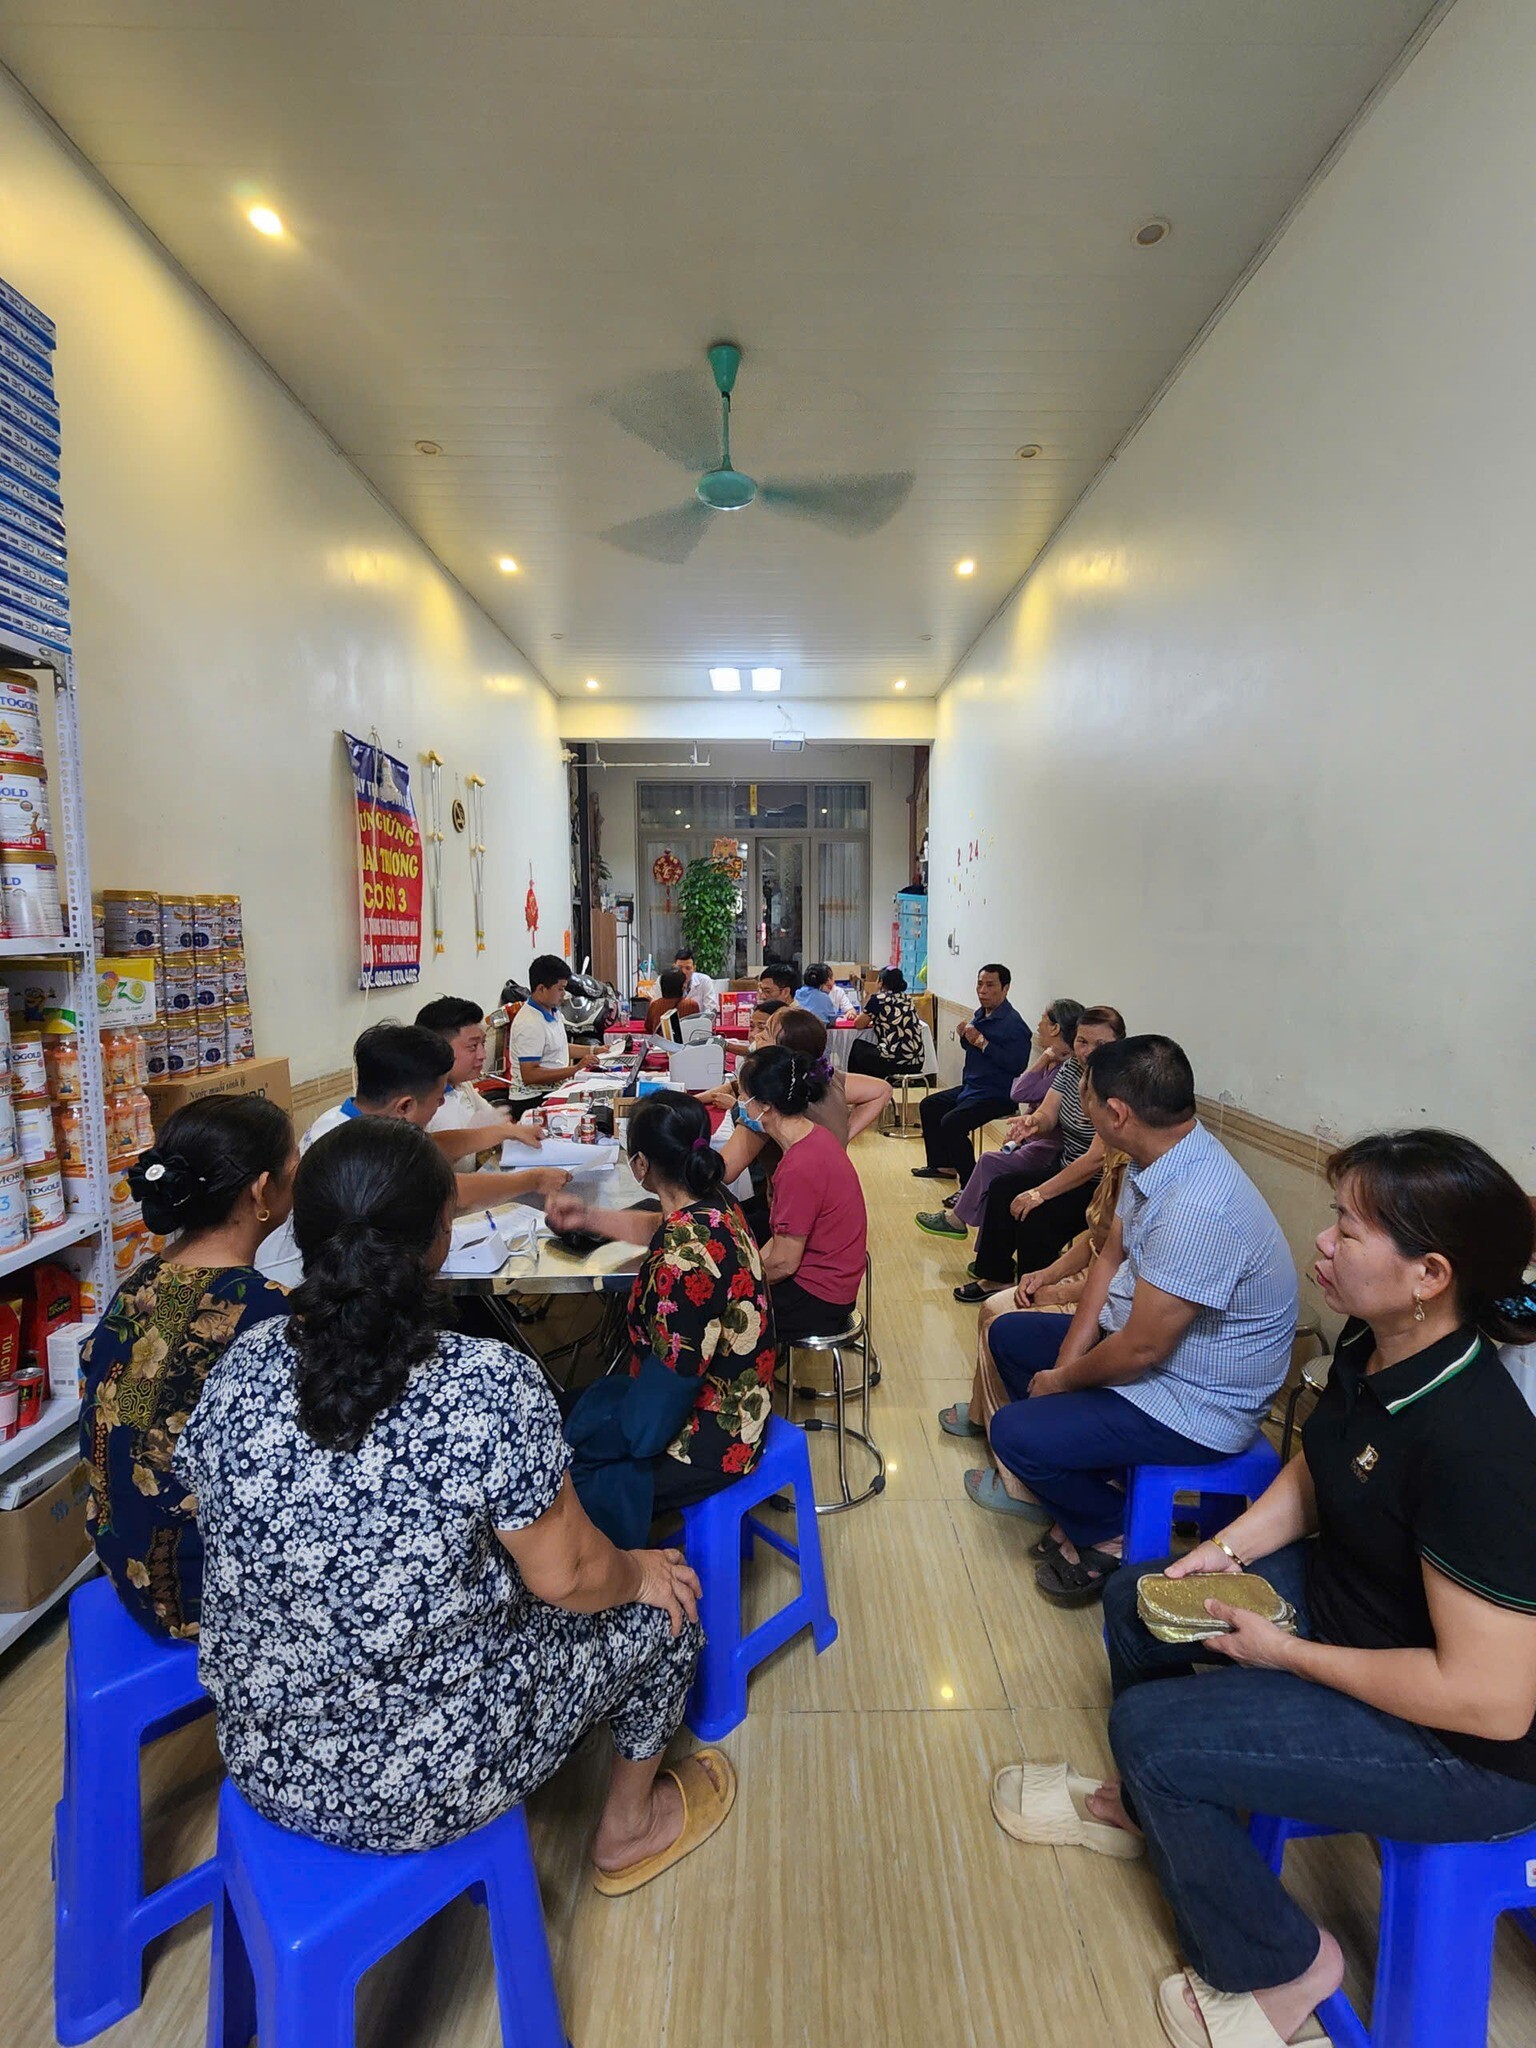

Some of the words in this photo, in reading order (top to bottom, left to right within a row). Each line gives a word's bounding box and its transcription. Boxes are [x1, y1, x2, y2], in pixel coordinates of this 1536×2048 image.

[7, 292, 21, 310] 3D
[25, 307, 54, 337] MASK
[3, 316, 17, 334] 3D
[20, 330, 52, 359] MASK
[4, 345, 19, 362] 3D
[22, 359, 52, 386] MASK
[11, 377, 26, 394] 3D
[28, 389, 57, 416] MASK
[13, 404, 27, 420] 3D
[30, 416, 59, 441] MASK
[13, 431, 27, 446] 3D
[30, 441, 58, 467] MASK
[13, 457, 26, 472] 3D
[29, 467, 58, 492] MASK
[20, 539, 34, 552] 3D
[22, 567, 36, 580] 3D
[23, 593, 37, 606] 3D
[40, 601, 68, 620] MASK
[25, 620, 39, 633] 3D
[41, 626, 69, 645] MASK
[0, 786, 28, 798] OLD
[398, 887, 407, 913] 3
